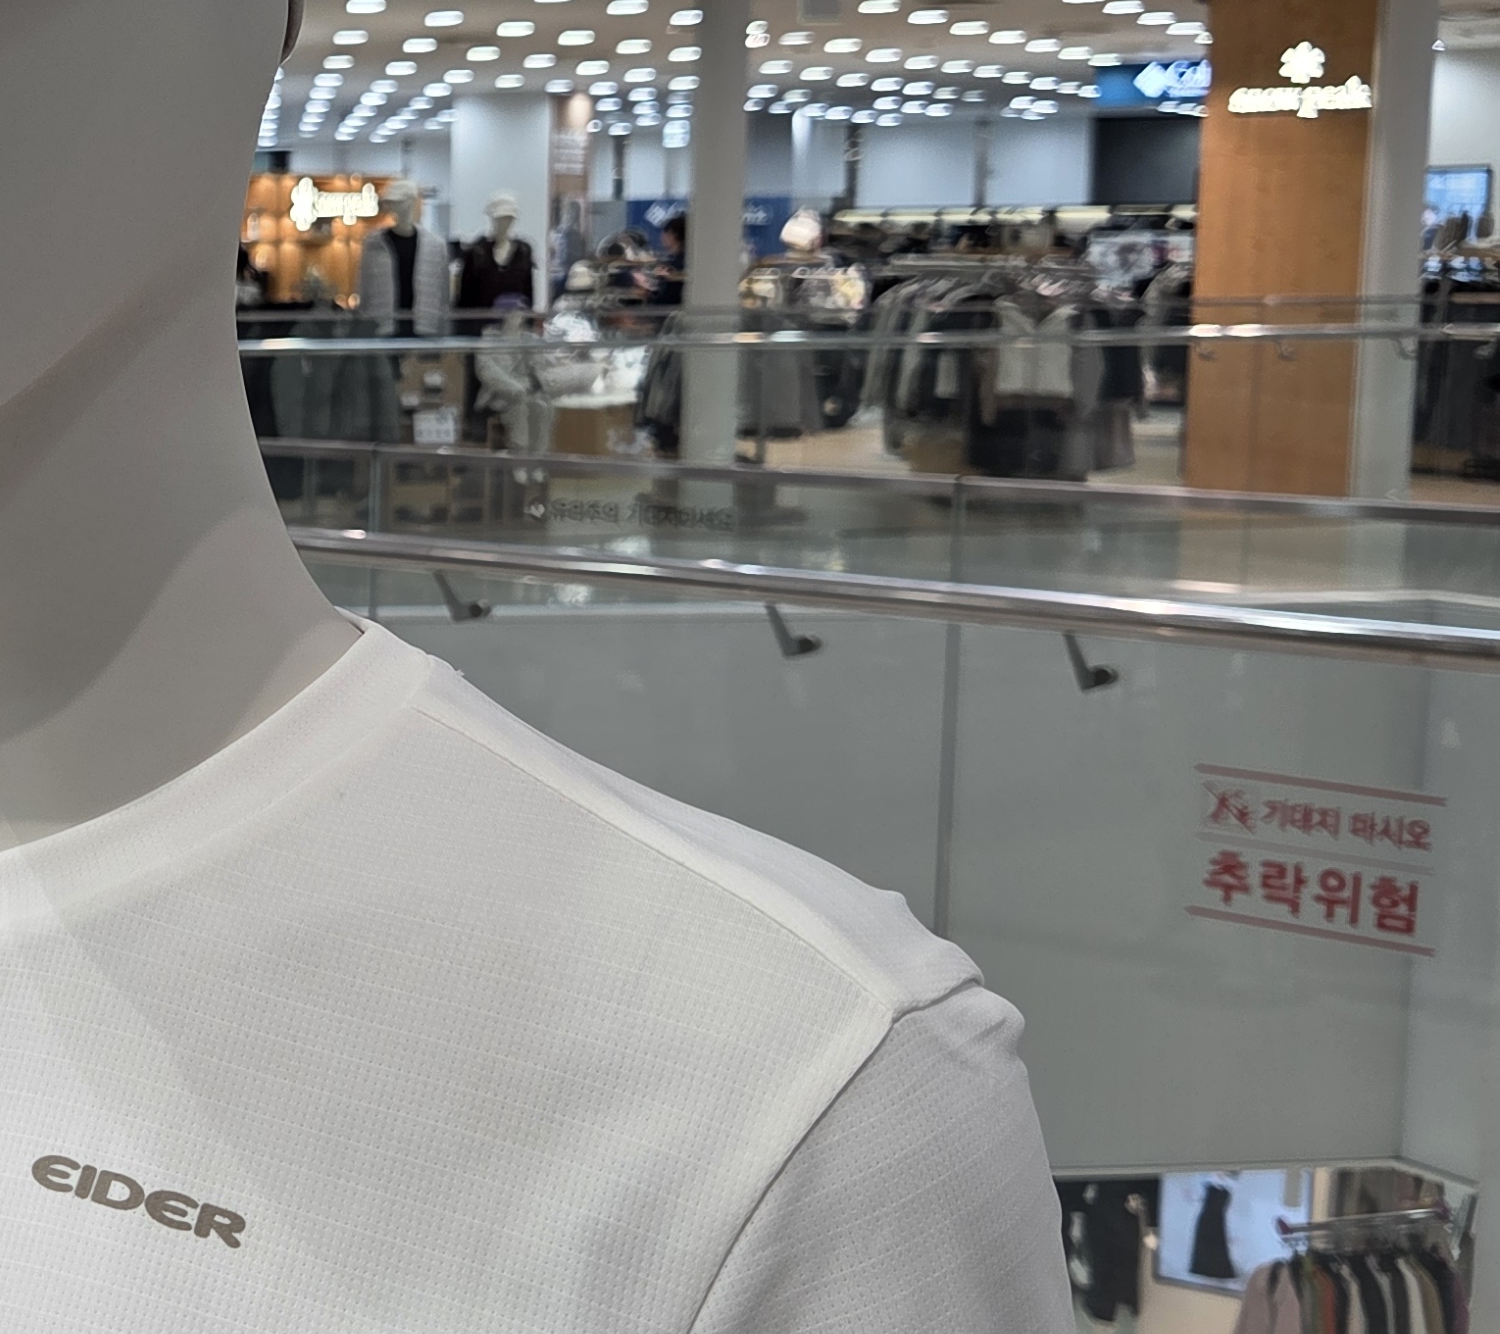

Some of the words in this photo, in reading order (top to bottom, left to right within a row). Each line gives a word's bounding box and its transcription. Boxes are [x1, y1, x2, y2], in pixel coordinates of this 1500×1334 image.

[1261, 797, 1342, 841] 기대지
[1349, 810, 1432, 852] 마시오
[1203, 849, 1420, 936] 추락위험
[31, 1154, 246, 1249] EIDER
